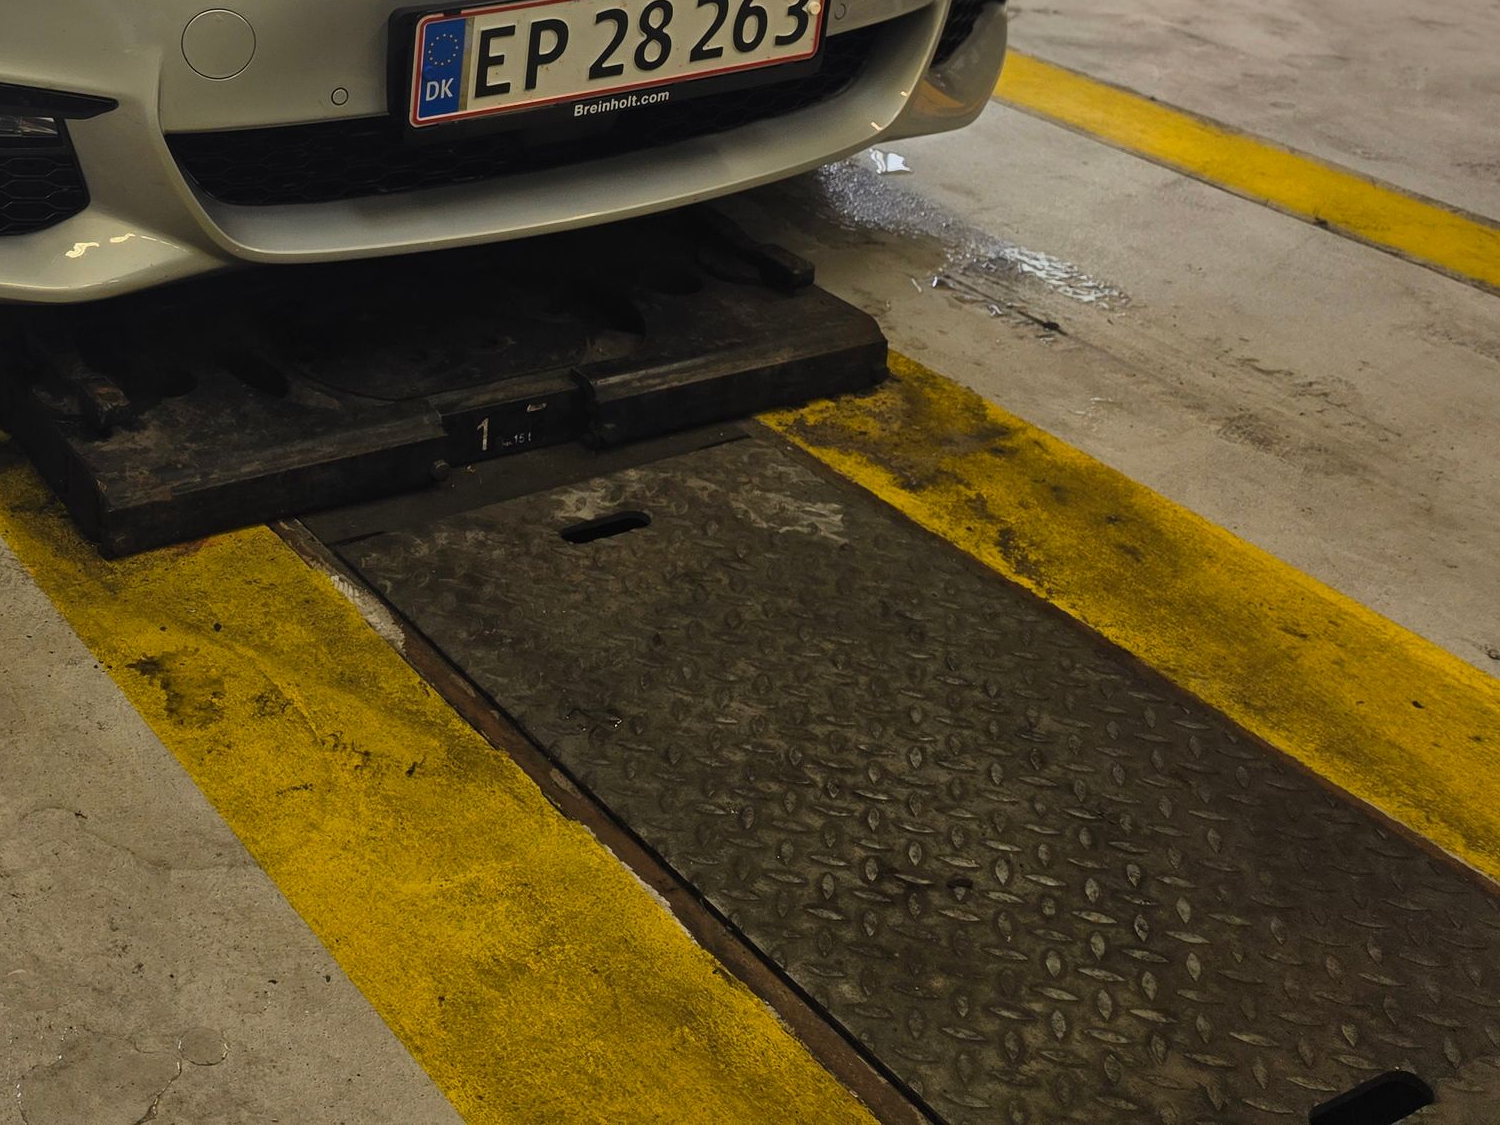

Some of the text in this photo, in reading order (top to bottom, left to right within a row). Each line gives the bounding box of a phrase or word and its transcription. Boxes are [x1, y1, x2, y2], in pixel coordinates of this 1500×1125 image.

[474, 18, 570, 98] EP
[425, 78, 454, 102] DK
[573, 91, 670, 117] Breinholt.com
[476, 418, 489, 451] 1
